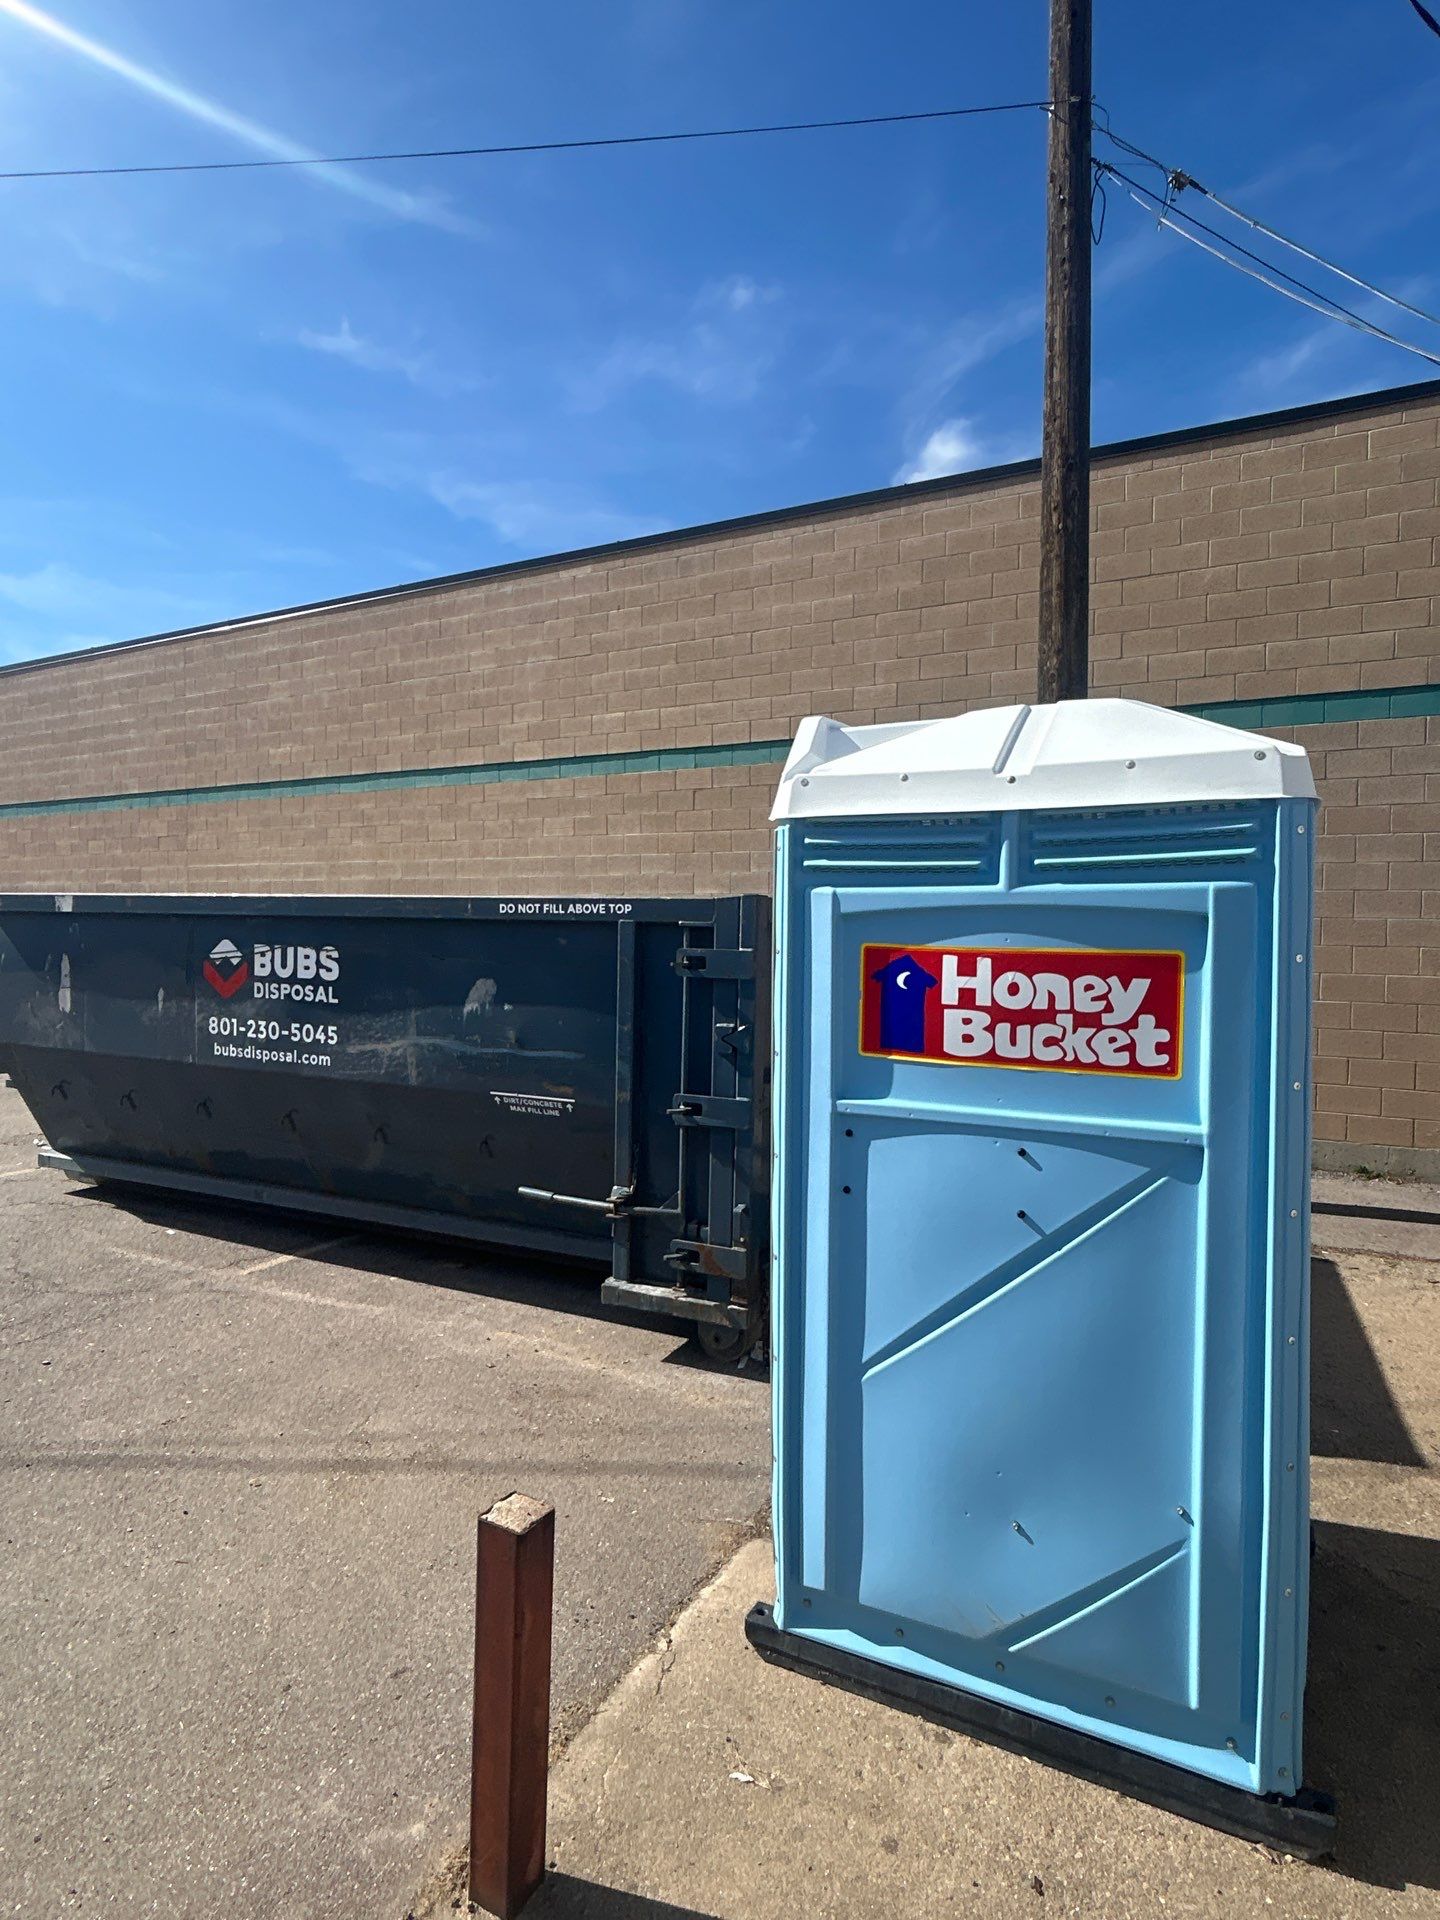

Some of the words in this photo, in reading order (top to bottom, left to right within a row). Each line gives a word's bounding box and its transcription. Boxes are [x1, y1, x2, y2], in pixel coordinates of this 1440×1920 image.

[499, 903, 516, 914] DO
[518, 903, 540, 914] NOT
[543, 903, 565, 914] FILL
[567, 903, 606, 914] ABOVE
[608, 903, 632, 914] TOP
[253, 943, 340, 981] BUBS
[253, 981, 339, 1004] DISPOSAL
[941, 954, 1151, 1026] Honey
[208, 1016, 338, 1045] 801-230-5045
[943, 1008, 1171, 1067] Bucket
[213, 1042, 331, 1067] bubsdisposal.com
[503, 1097, 563, 1109] DIRT/CONCRETE
[509, 1105, 526, 1113] MAX
[527, 1107, 542, 1115] FILL
[543, 1109, 560, 1117] LINE
